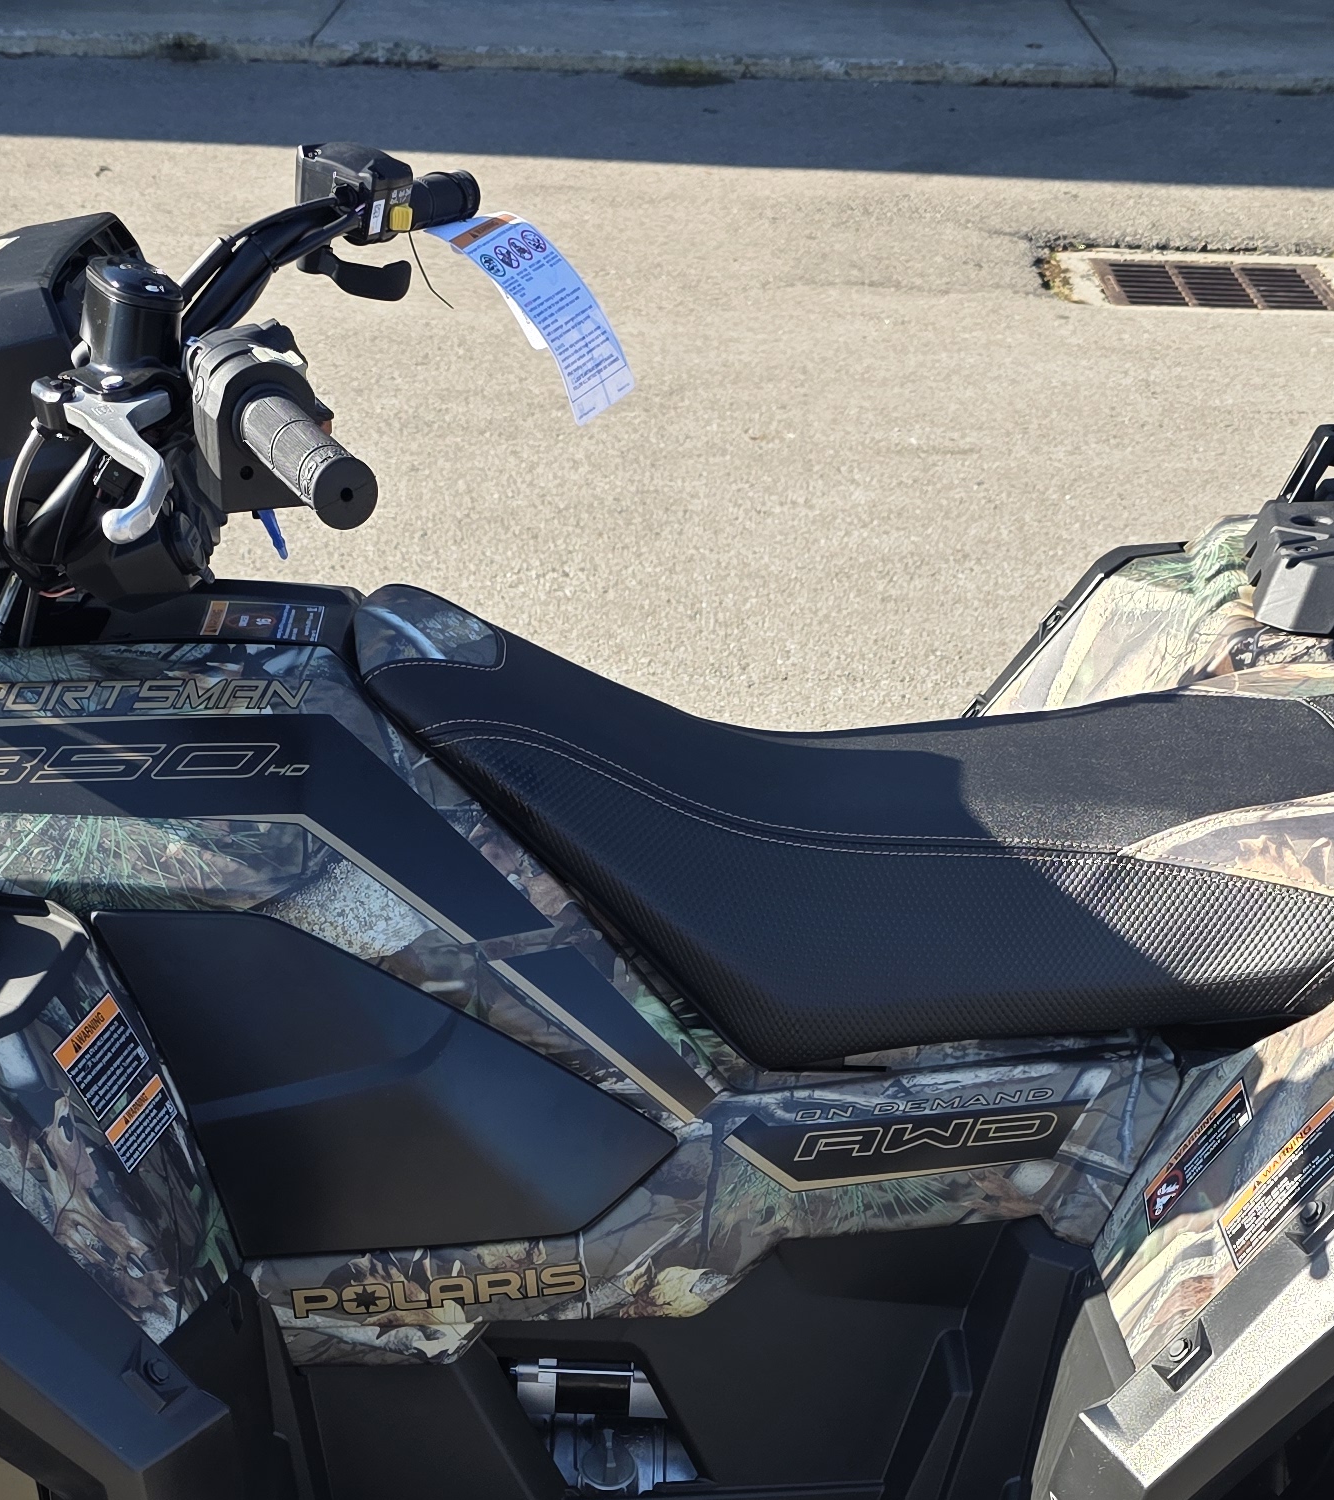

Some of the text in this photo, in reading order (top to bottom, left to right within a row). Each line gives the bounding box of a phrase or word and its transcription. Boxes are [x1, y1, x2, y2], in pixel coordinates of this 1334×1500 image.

[75, 1012, 105, 1046] WARNING
[127, 1092, 149, 1122] WARNING
[795, 1087, 1055, 1122] ON DEMAND
[794, 1111, 1058, 1162] AWD
[1172, 1110, 1218, 1163] WARNING
[1262, 1124, 1313, 1179] WARNING
[291, 1262, 587, 1319] POLARIS
